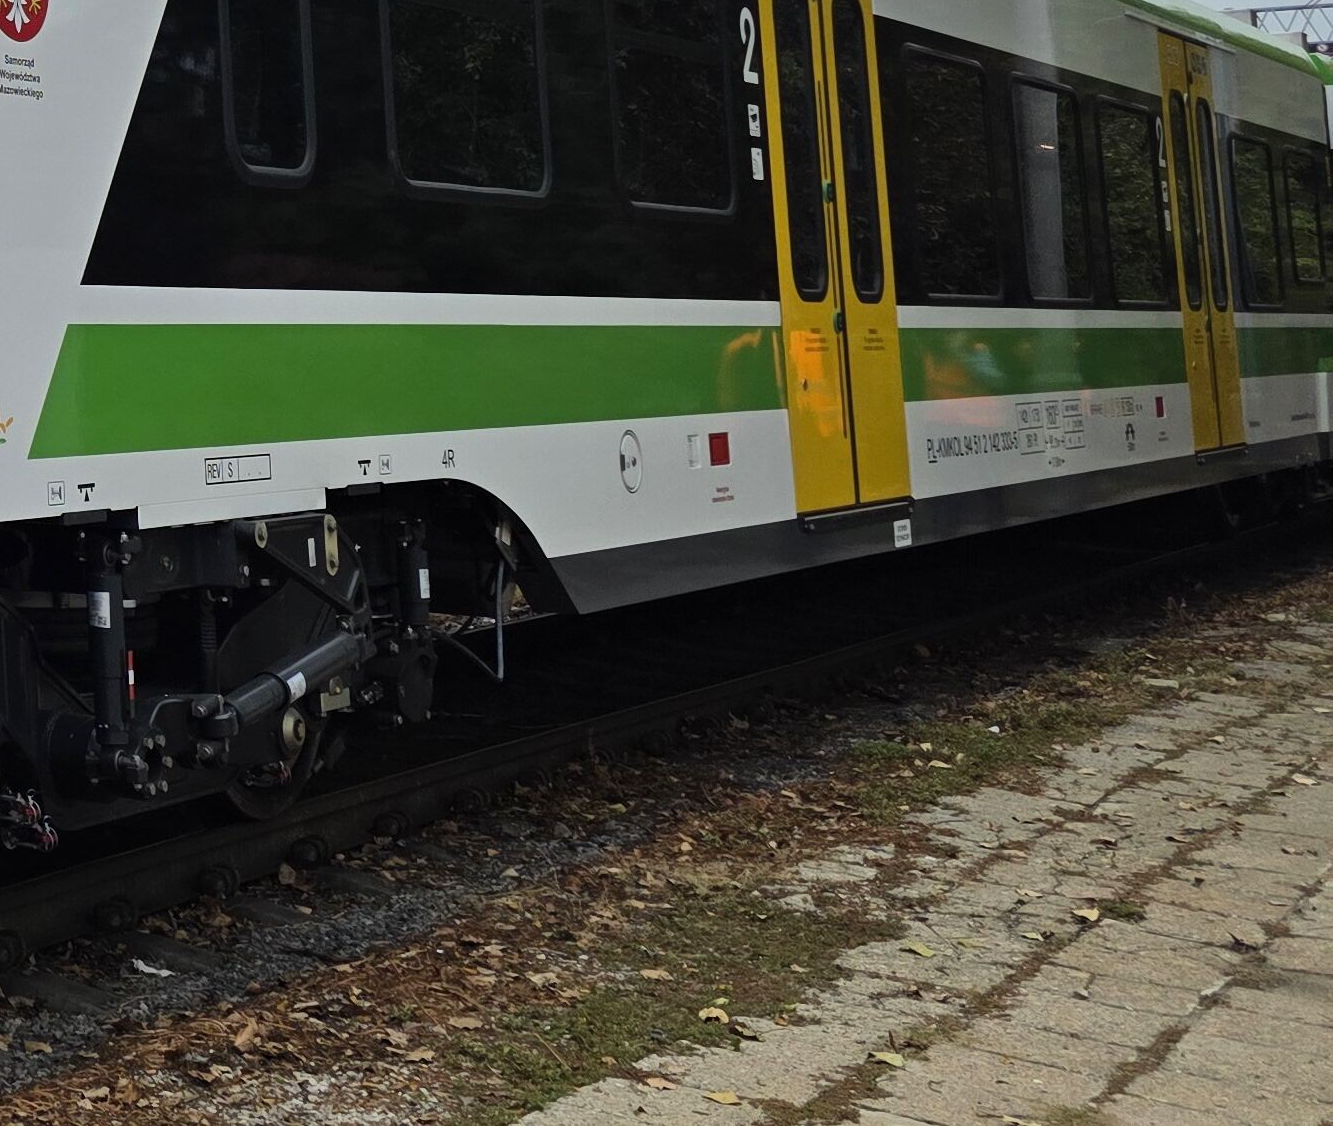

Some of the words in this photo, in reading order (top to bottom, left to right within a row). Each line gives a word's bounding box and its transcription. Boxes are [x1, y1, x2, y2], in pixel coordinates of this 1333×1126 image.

[739, 6, 759, 85] 2
[4, 54, 35, 69] Samorząd
[1155, 116, 1166, 168] 2
[441, 449, 456, 469] 4R
[206, 463, 221, 480] REV
[227, 461, 234, 478] S
